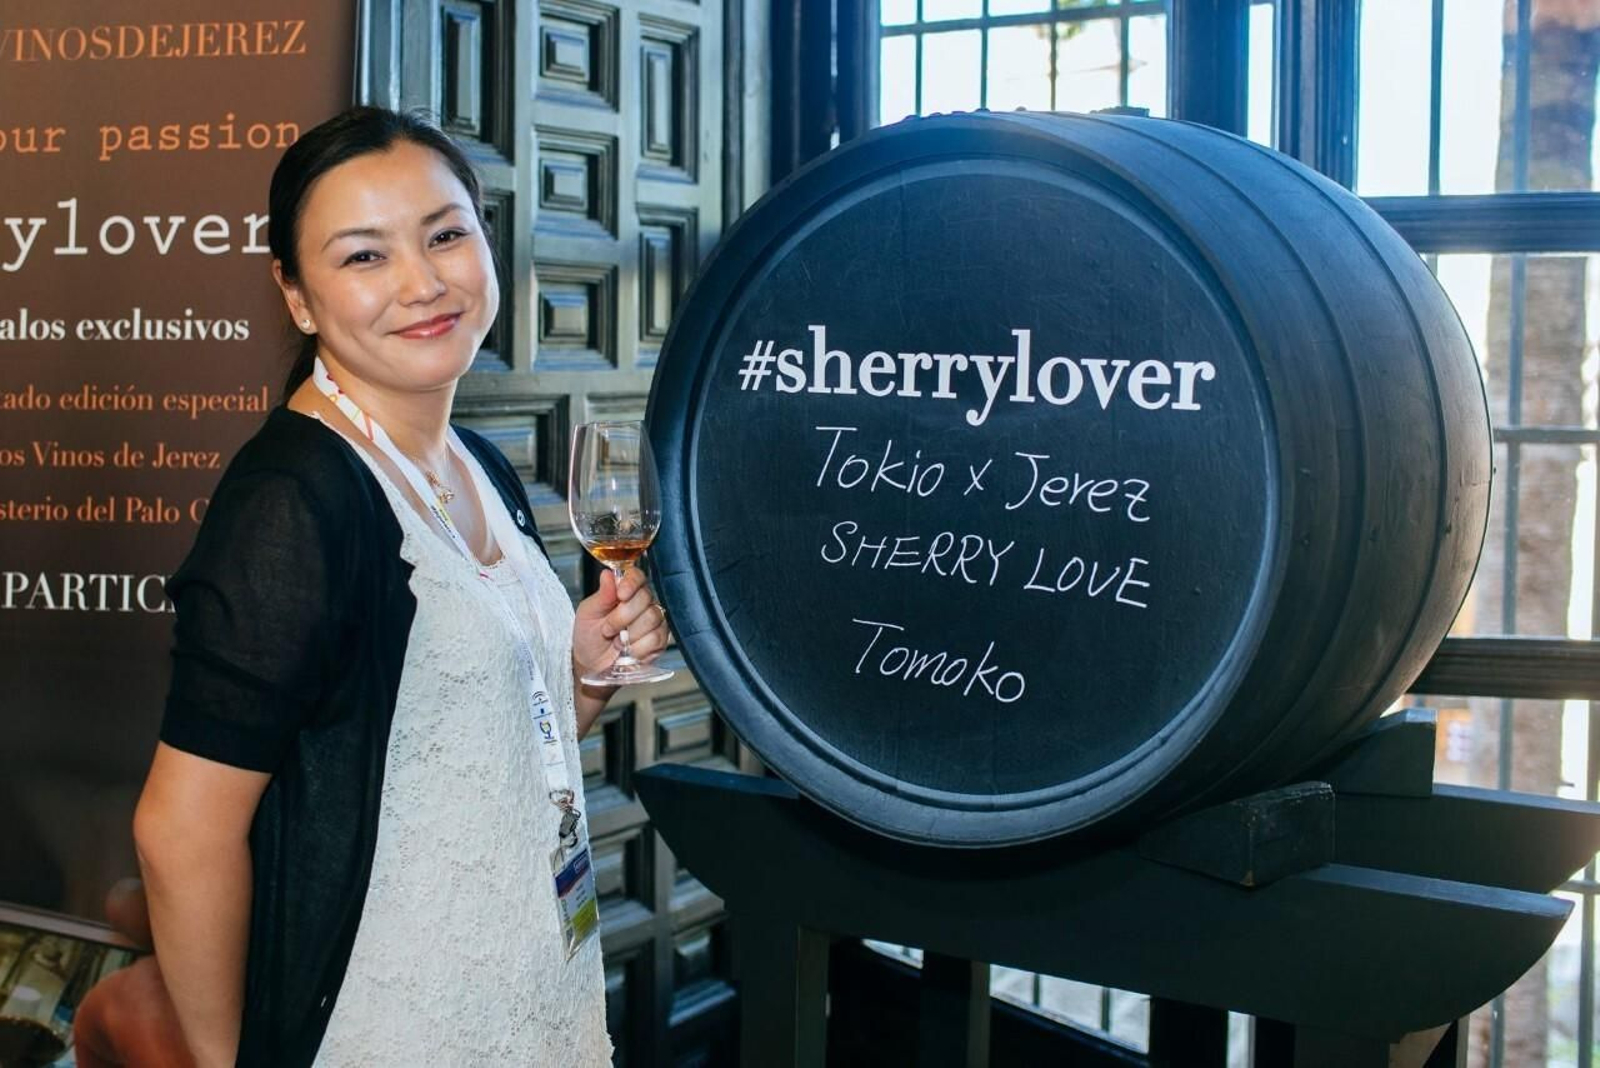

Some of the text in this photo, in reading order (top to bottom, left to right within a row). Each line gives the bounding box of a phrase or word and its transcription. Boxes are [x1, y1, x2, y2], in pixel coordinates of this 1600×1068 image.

[99, 112, 300, 161] passion
[2, 197, 271, 272] ylover
[0, 308, 250, 341] alos exclusivos
[59, 384, 153, 411] edición
[163, 386, 268, 419] especial
[738, 325, 1216, 426] #sherrylover
[32, 441, 105, 468] Vinos
[113, 442, 145, 468] de
[152, 443, 221, 469] Jerez
[815, 426, 945, 497] Tokio
[1005, 452, 1151, 522] Jerez
[76, 496, 115, 522] del
[125, 497, 180, 523] Palo
[820, 521, 1151, 608] SHERRY LOVE
[852, 618, 1026, 703] Tomoko
